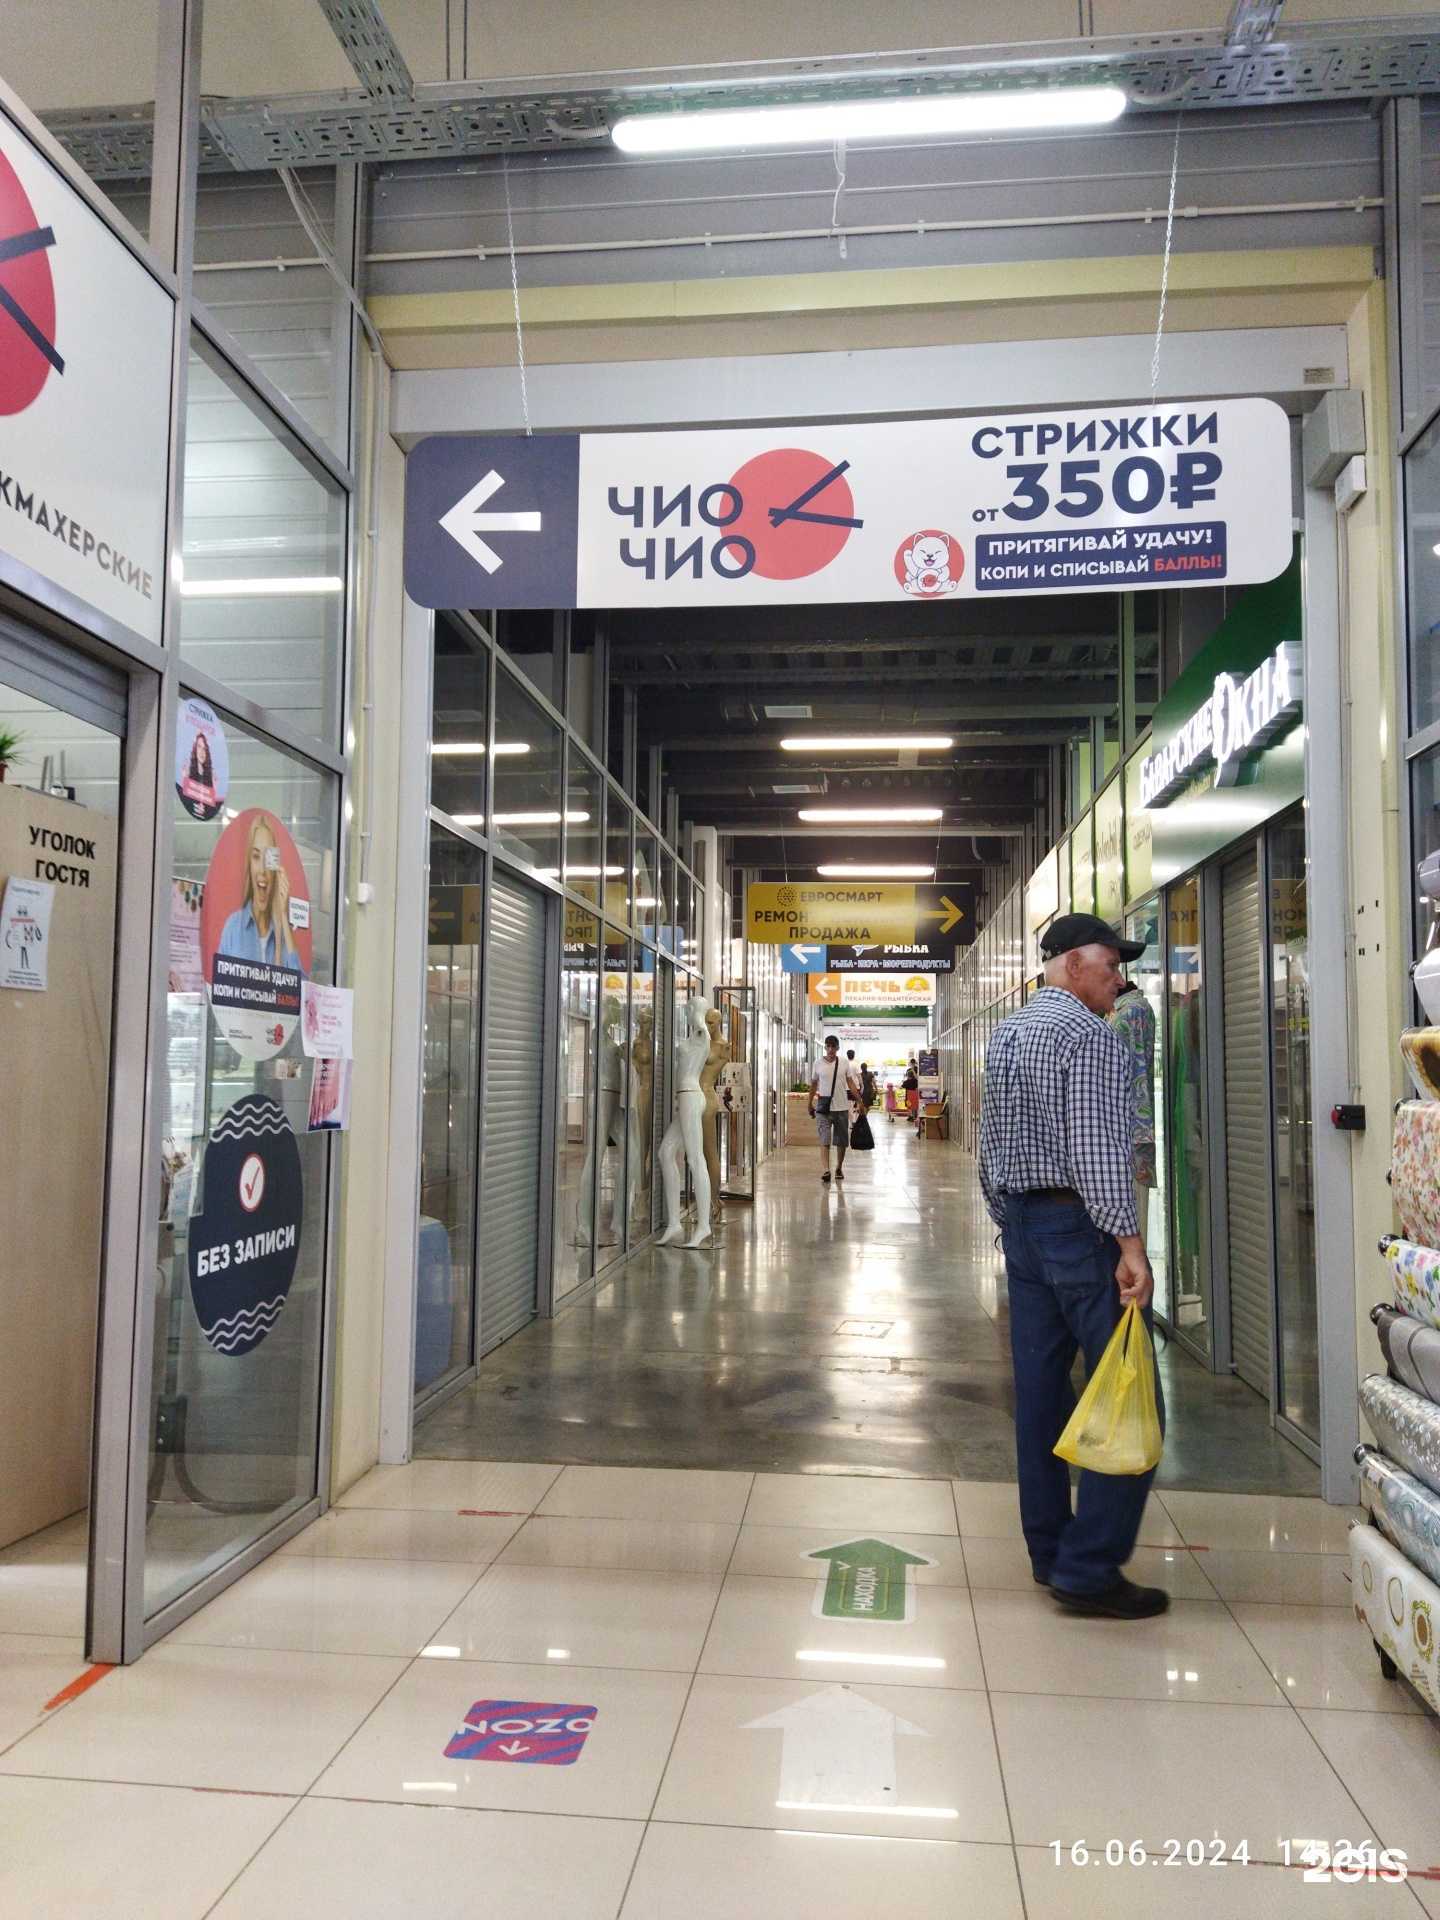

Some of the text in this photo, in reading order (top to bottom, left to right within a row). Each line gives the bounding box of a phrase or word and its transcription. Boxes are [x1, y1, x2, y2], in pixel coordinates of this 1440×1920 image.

[971, 411, 1219, 459] СТРИЖКИ
[1001, 451, 1223, 521] 350₽
[607, 483, 744, 529] ЧИО
[618, 534, 757, 581] ЧИО
[989, 528, 1213, 556] ПРИТЯГИВАЙ УДАЧУ!
[981, 554, 1222, 580] КОПИ И СПИСЫВАЙ БАЛЛЫ!
[29, 824, 97, 861] УГОЛОК
[35, 856, 91, 889] ГОСТЯ
[799, 891, 884, 904] ЕВРОСМАРТ
[754, 911, 811, 923] РЕМОН
[789, 926, 871, 941] ПРОДАЖА
[217, 960, 270, 982] ПРИТЯГИВАЙ
[197, 1223, 296, 1277] БЕЗ ЗАПИСИ
